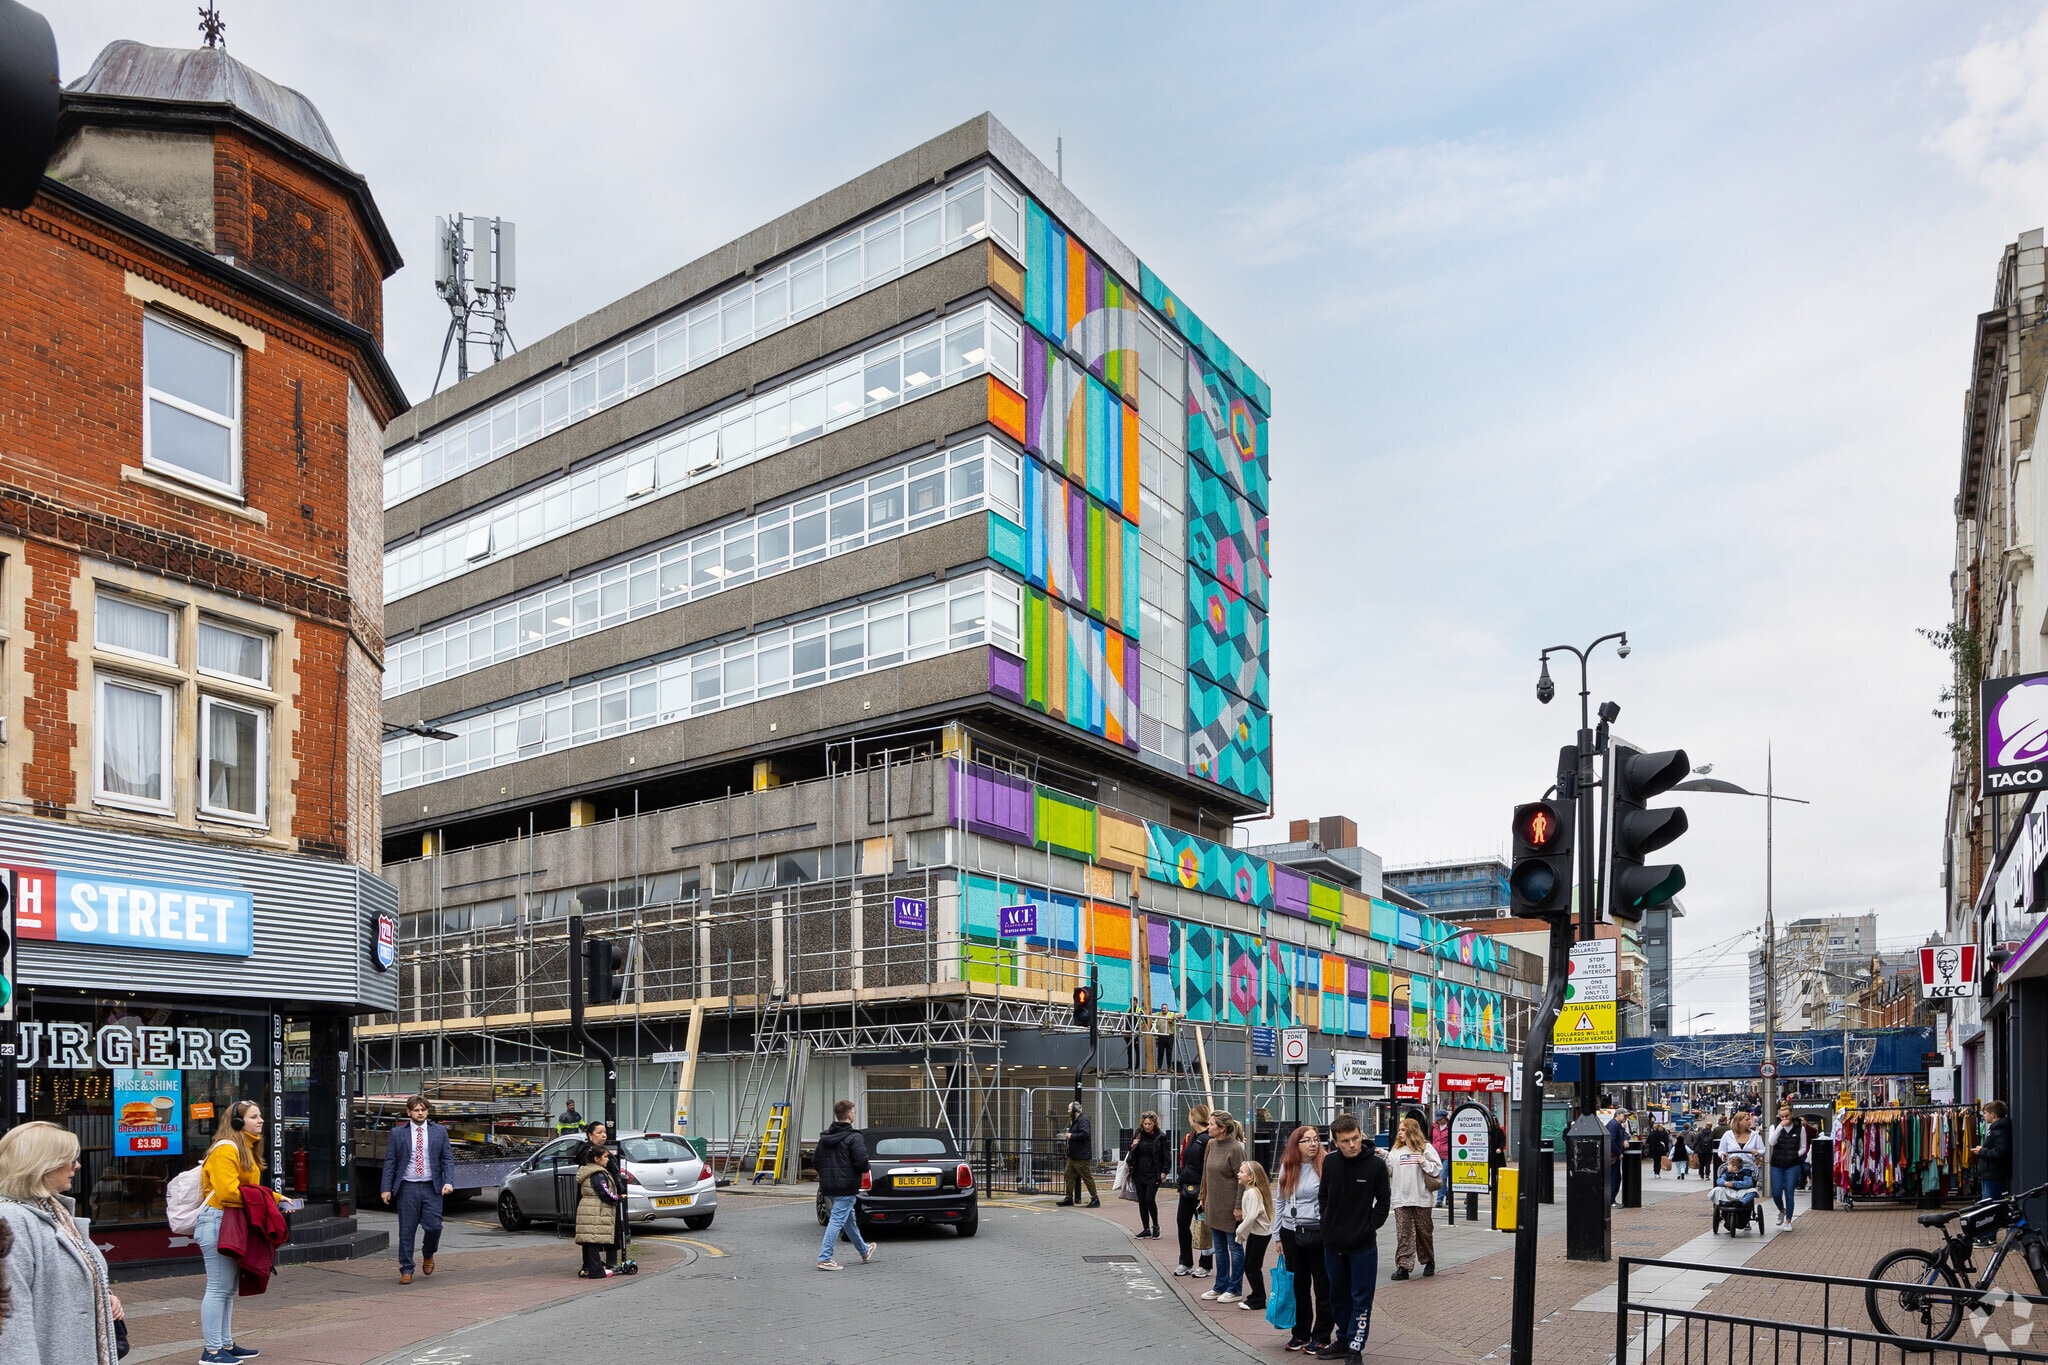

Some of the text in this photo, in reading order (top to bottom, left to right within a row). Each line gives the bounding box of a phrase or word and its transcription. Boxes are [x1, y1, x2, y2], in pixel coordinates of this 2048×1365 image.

[1988, 769, 2043, 788] TACO
[70, 883, 234, 943] STREET
[899, 901, 922, 917] ACE
[1006, 908, 1034, 924] ACE
[1930, 985, 1967, 997] KFC
[1570, 1003, 1612, 1011] TAILGATING
[1, 1046, 14, 1055] 23
[17, 1022, 251, 1070] URGERS
[1352, 1067, 1373, 1076] DISCOUNT
[274, 1014, 282, 1194] BURGERS
[339, 1050, 348, 1167] WINGS
[118, 1123, 179, 1133] BREAKFAST MEAL
[137, 1138, 161, 1149] £3.99
[898, 1177, 915, 1185] BL16
[1349, 1309, 1368, 1351] Bench.
